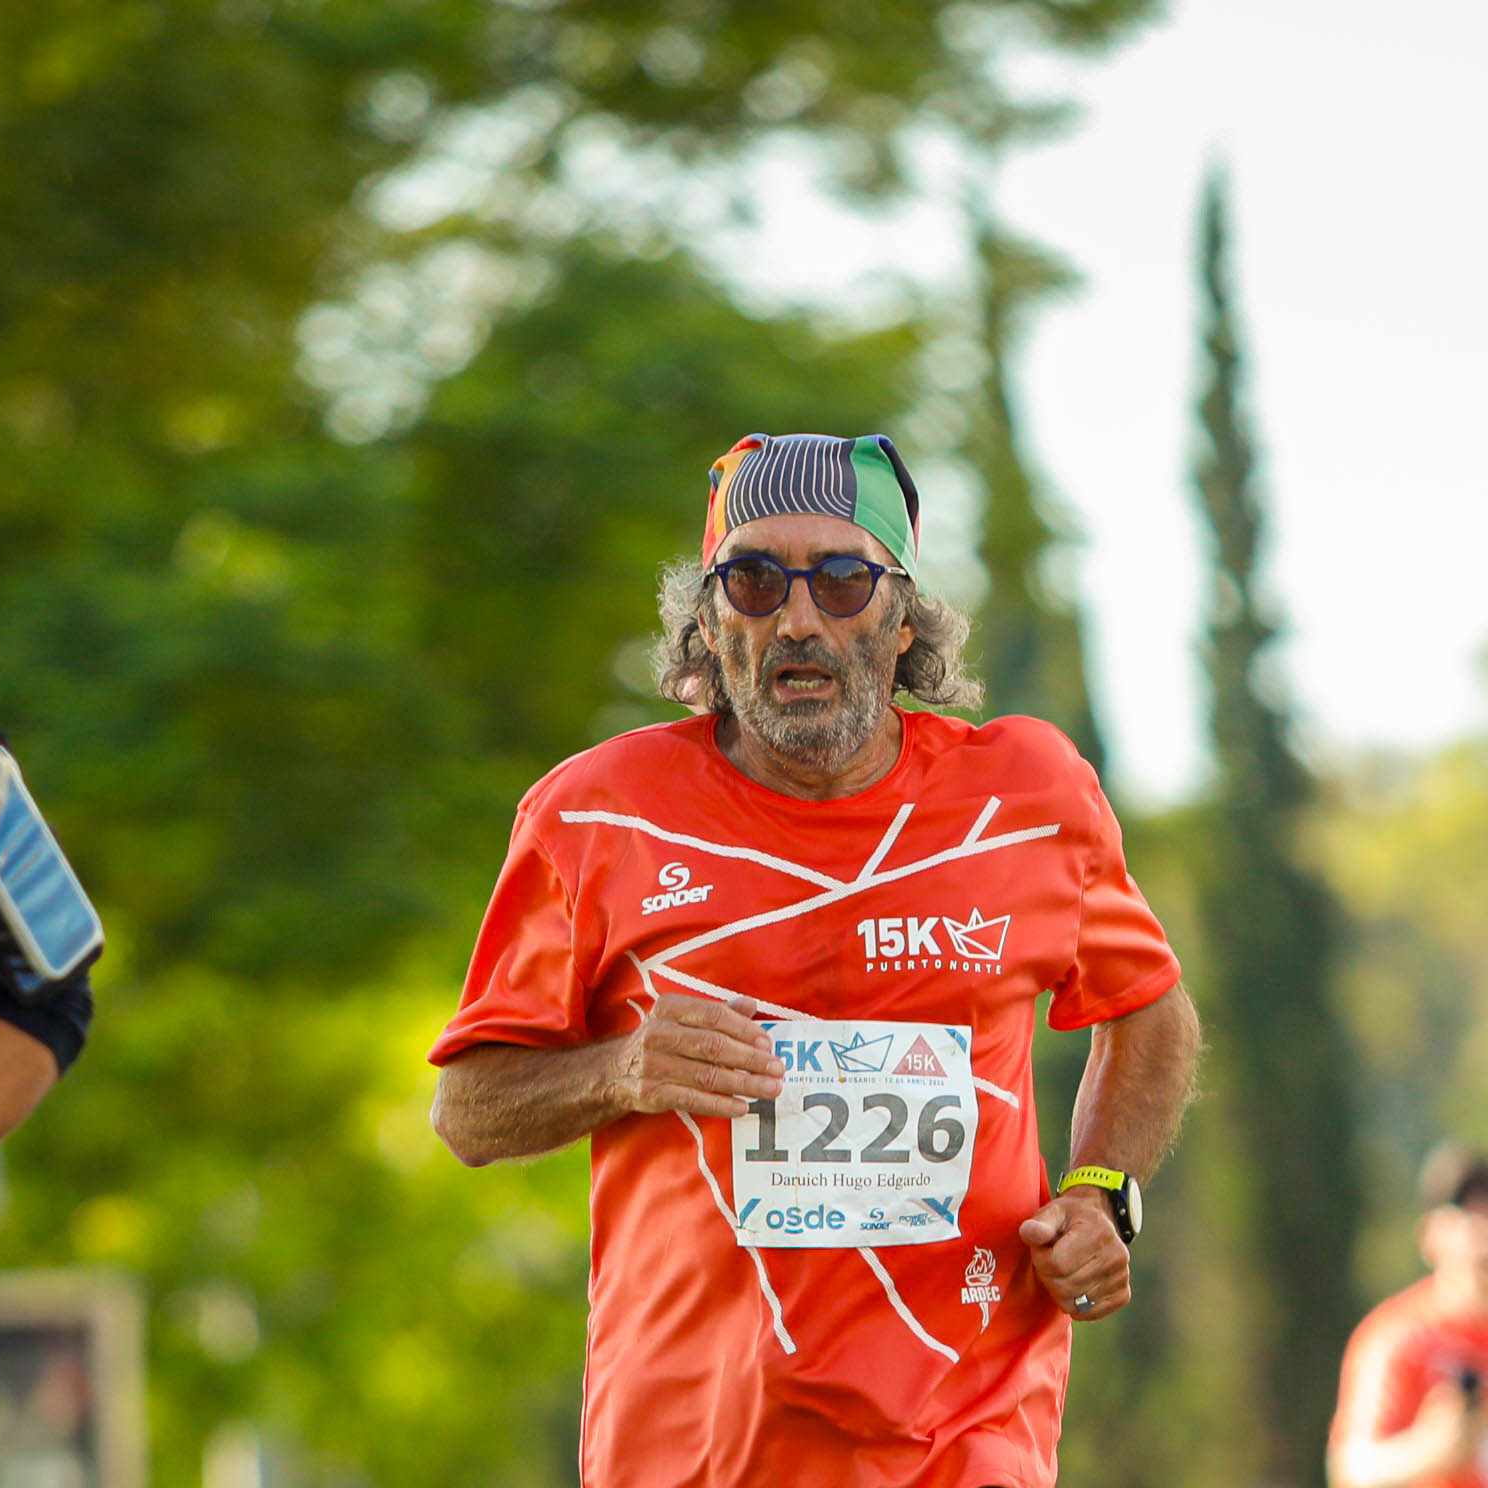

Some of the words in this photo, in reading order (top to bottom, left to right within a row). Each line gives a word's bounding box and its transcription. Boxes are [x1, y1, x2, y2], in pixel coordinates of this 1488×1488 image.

[857, 916, 942, 958] 15K
[774, 1041, 824, 1072] 5K
[904, 1053, 936, 1072] 15K
[745, 1092, 966, 1163] 1226
[770, 1171, 828, 1188] Daruich
[833, 1173, 872, 1191] Hugo
[877, 1172, 931, 1189] Edgardo
[766, 1203, 846, 1232] osde
[961, 1285, 1001, 1305] ARDEC
